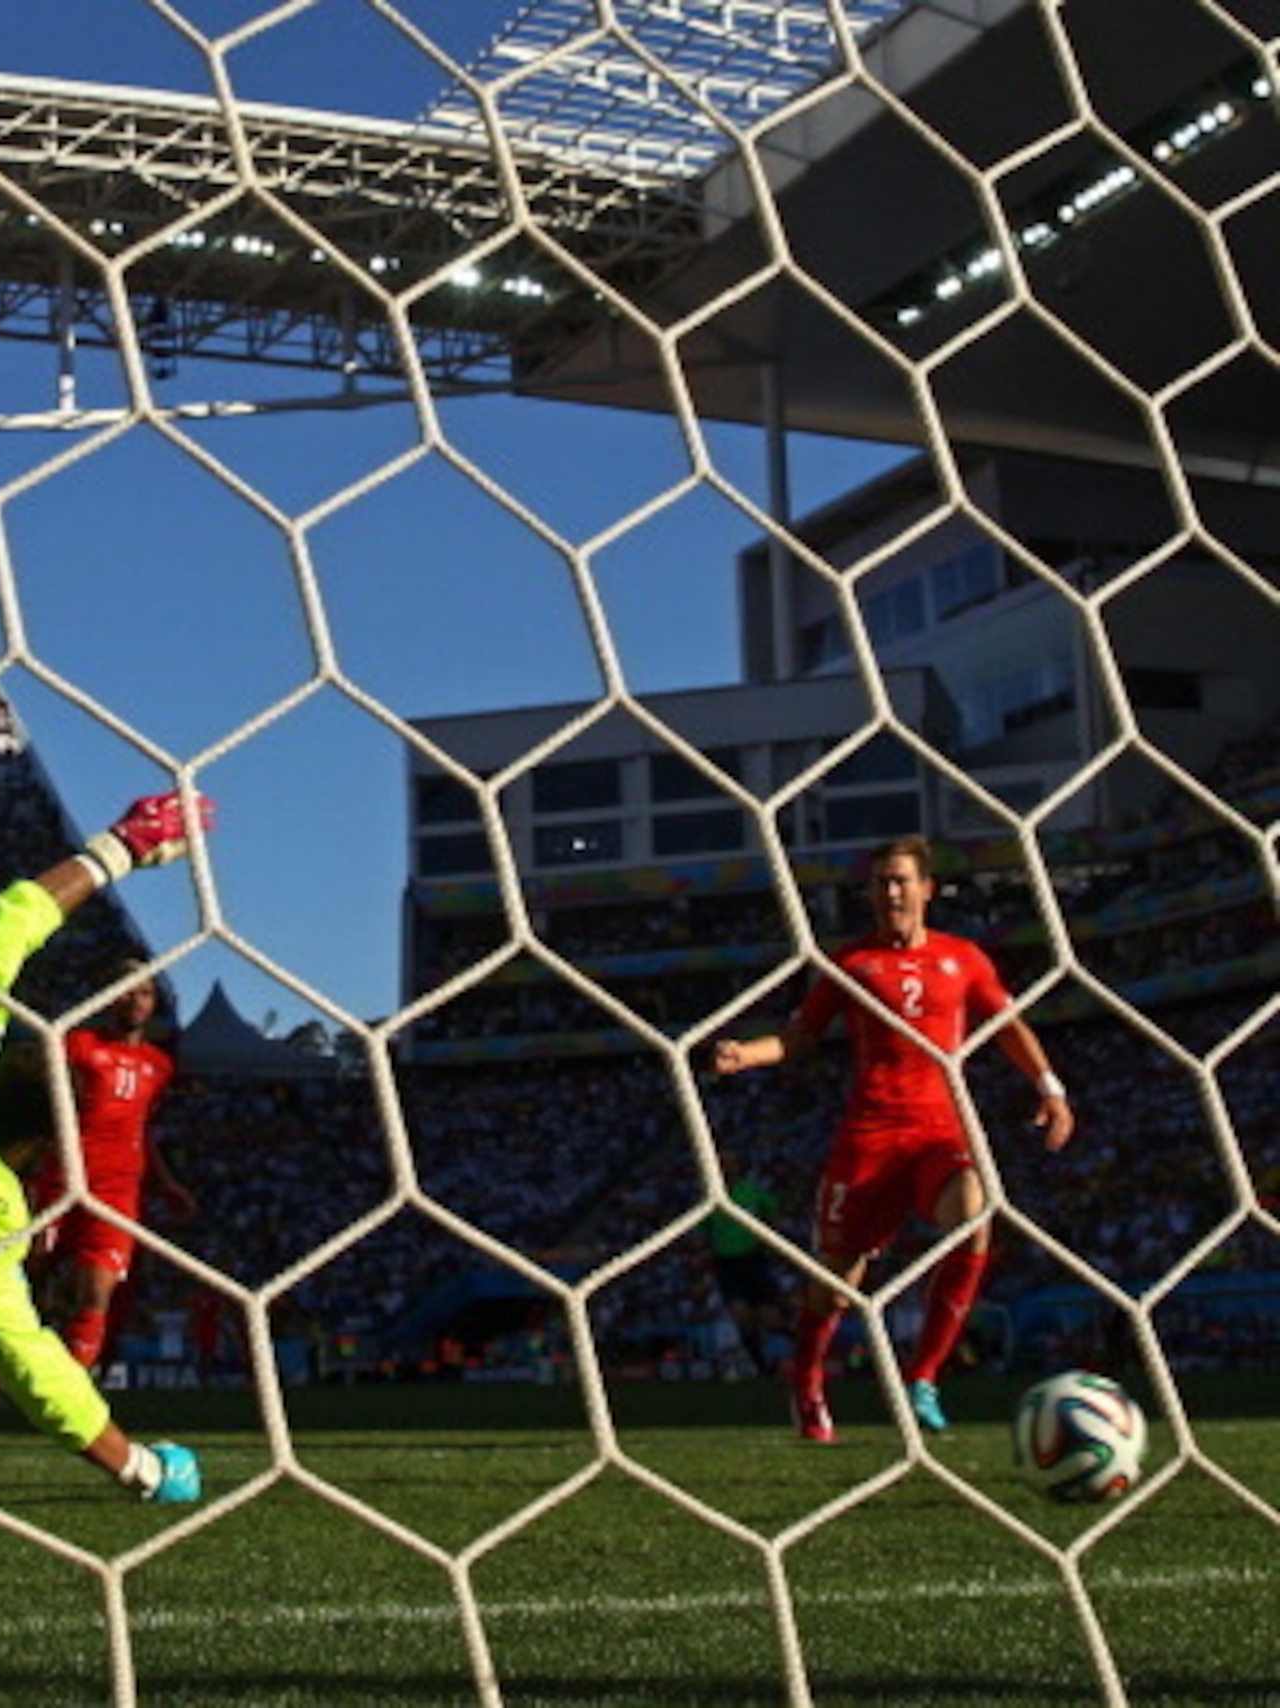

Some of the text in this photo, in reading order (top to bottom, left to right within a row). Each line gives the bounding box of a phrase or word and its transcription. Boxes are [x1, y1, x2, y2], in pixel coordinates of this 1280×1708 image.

[901, 974, 924, 1018] 2
[114, 1066, 137, 1100] 11
[828, 1182, 846, 1222] 2
